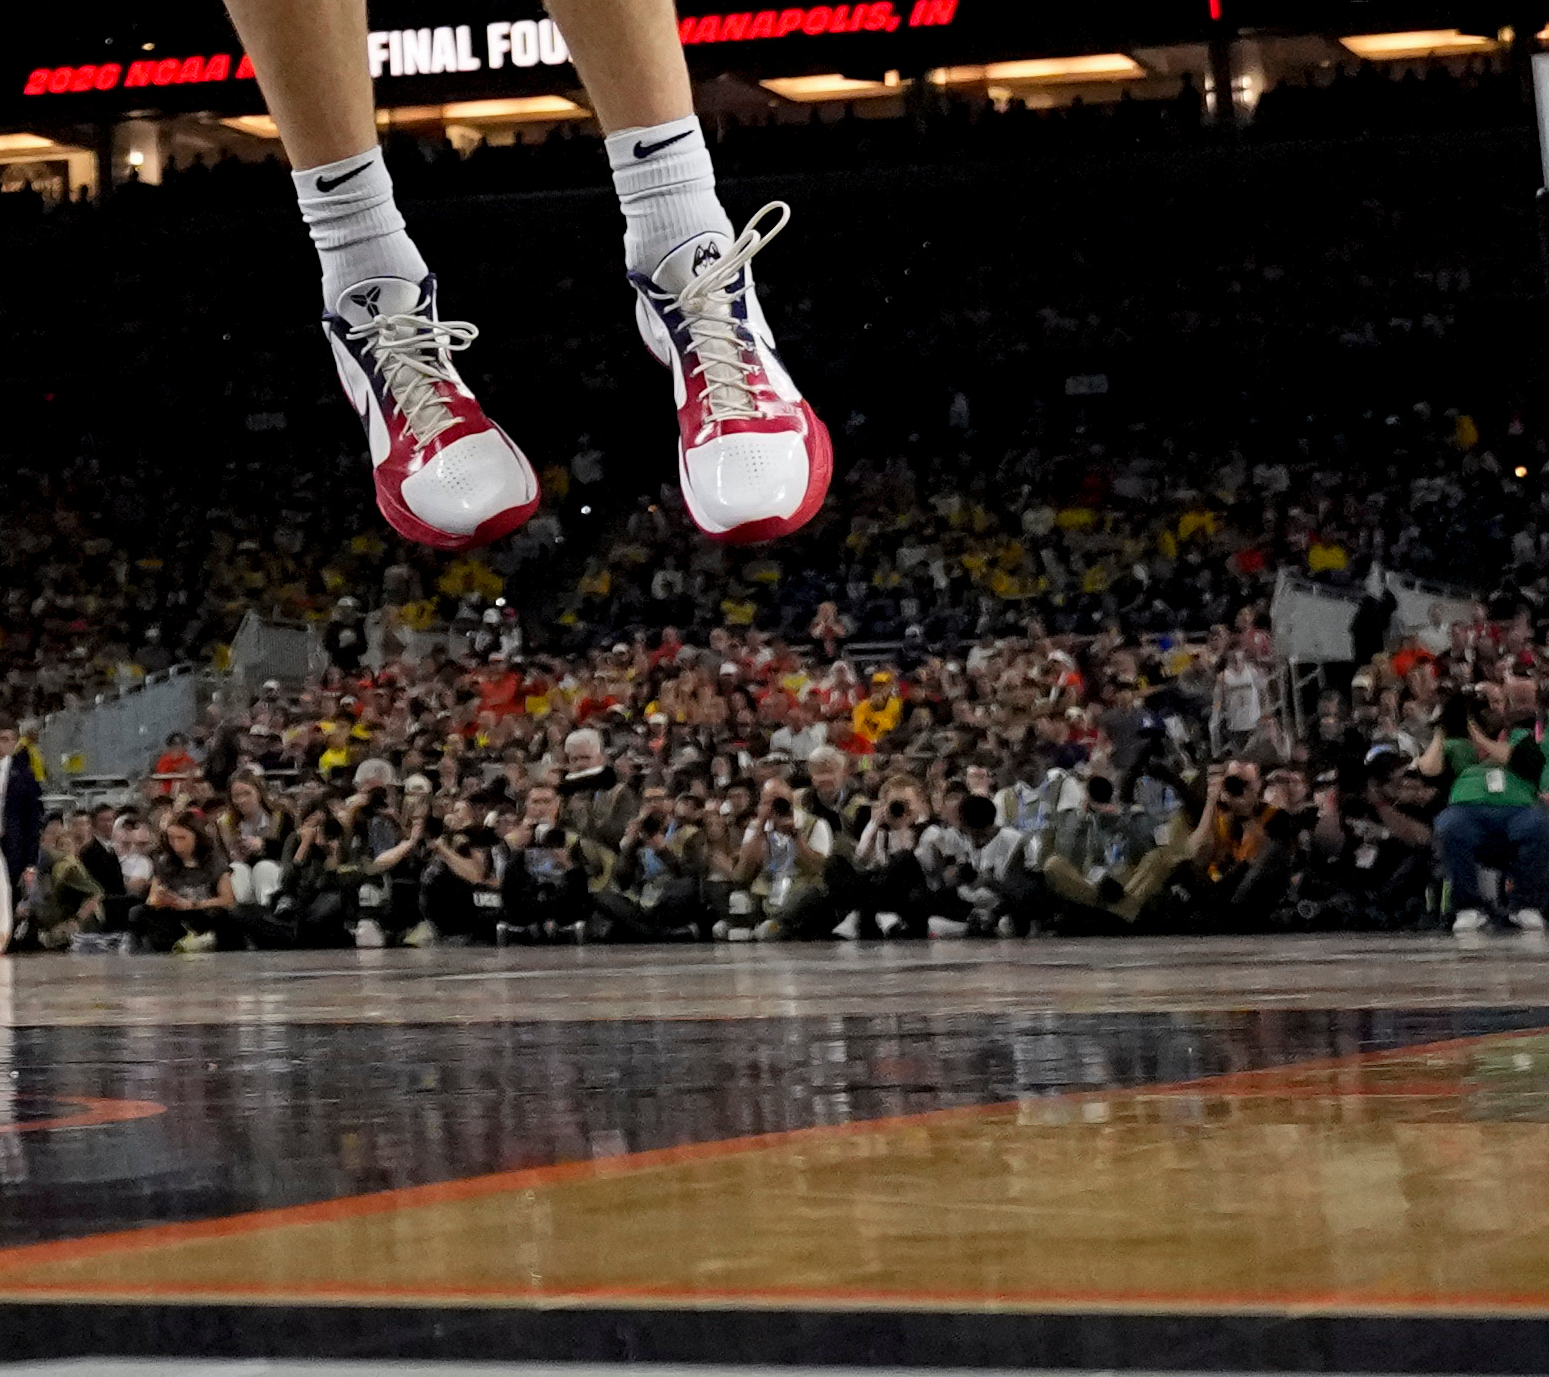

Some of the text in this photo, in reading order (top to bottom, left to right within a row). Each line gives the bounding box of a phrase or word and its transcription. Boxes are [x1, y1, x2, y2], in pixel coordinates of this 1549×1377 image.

[24, 66, 119, 95] 2026
[124, 56, 230, 88] NCAA
[368, 26, 481, 78] FINAL
[486, 20, 578, 70] FOU
